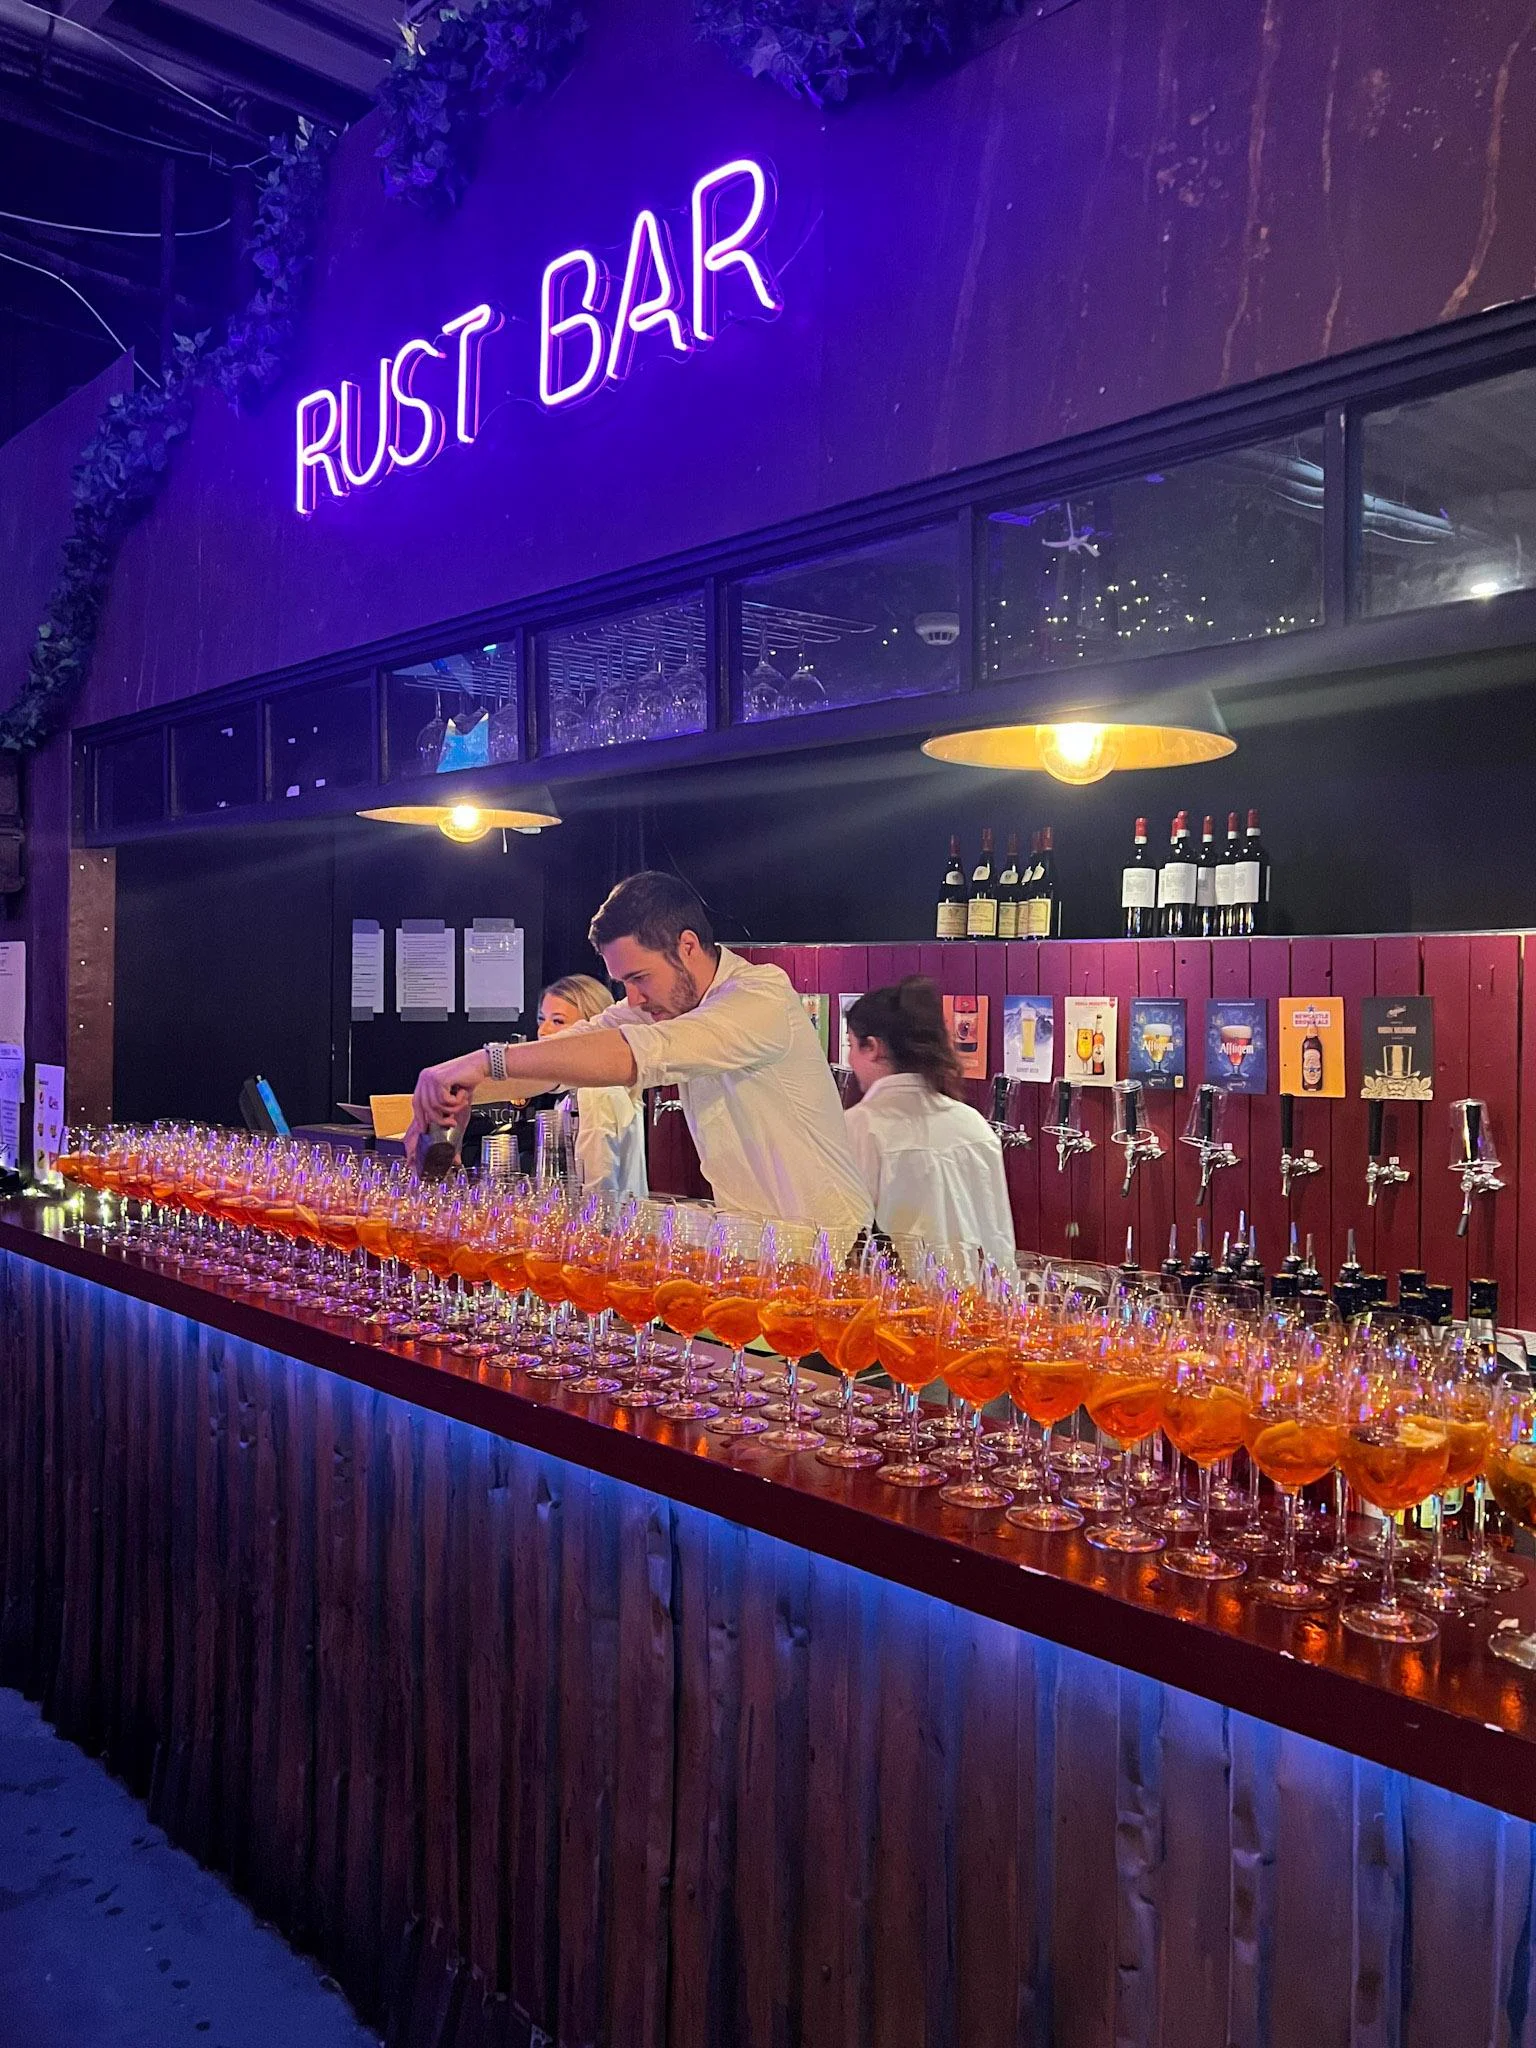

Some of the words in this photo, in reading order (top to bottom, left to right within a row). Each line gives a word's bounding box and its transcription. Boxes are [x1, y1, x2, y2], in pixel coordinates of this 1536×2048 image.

[296, 303, 496, 516] RUST
[539, 157, 784, 406] BAR
[1219, 1042, 1254, 1056] Affligem
